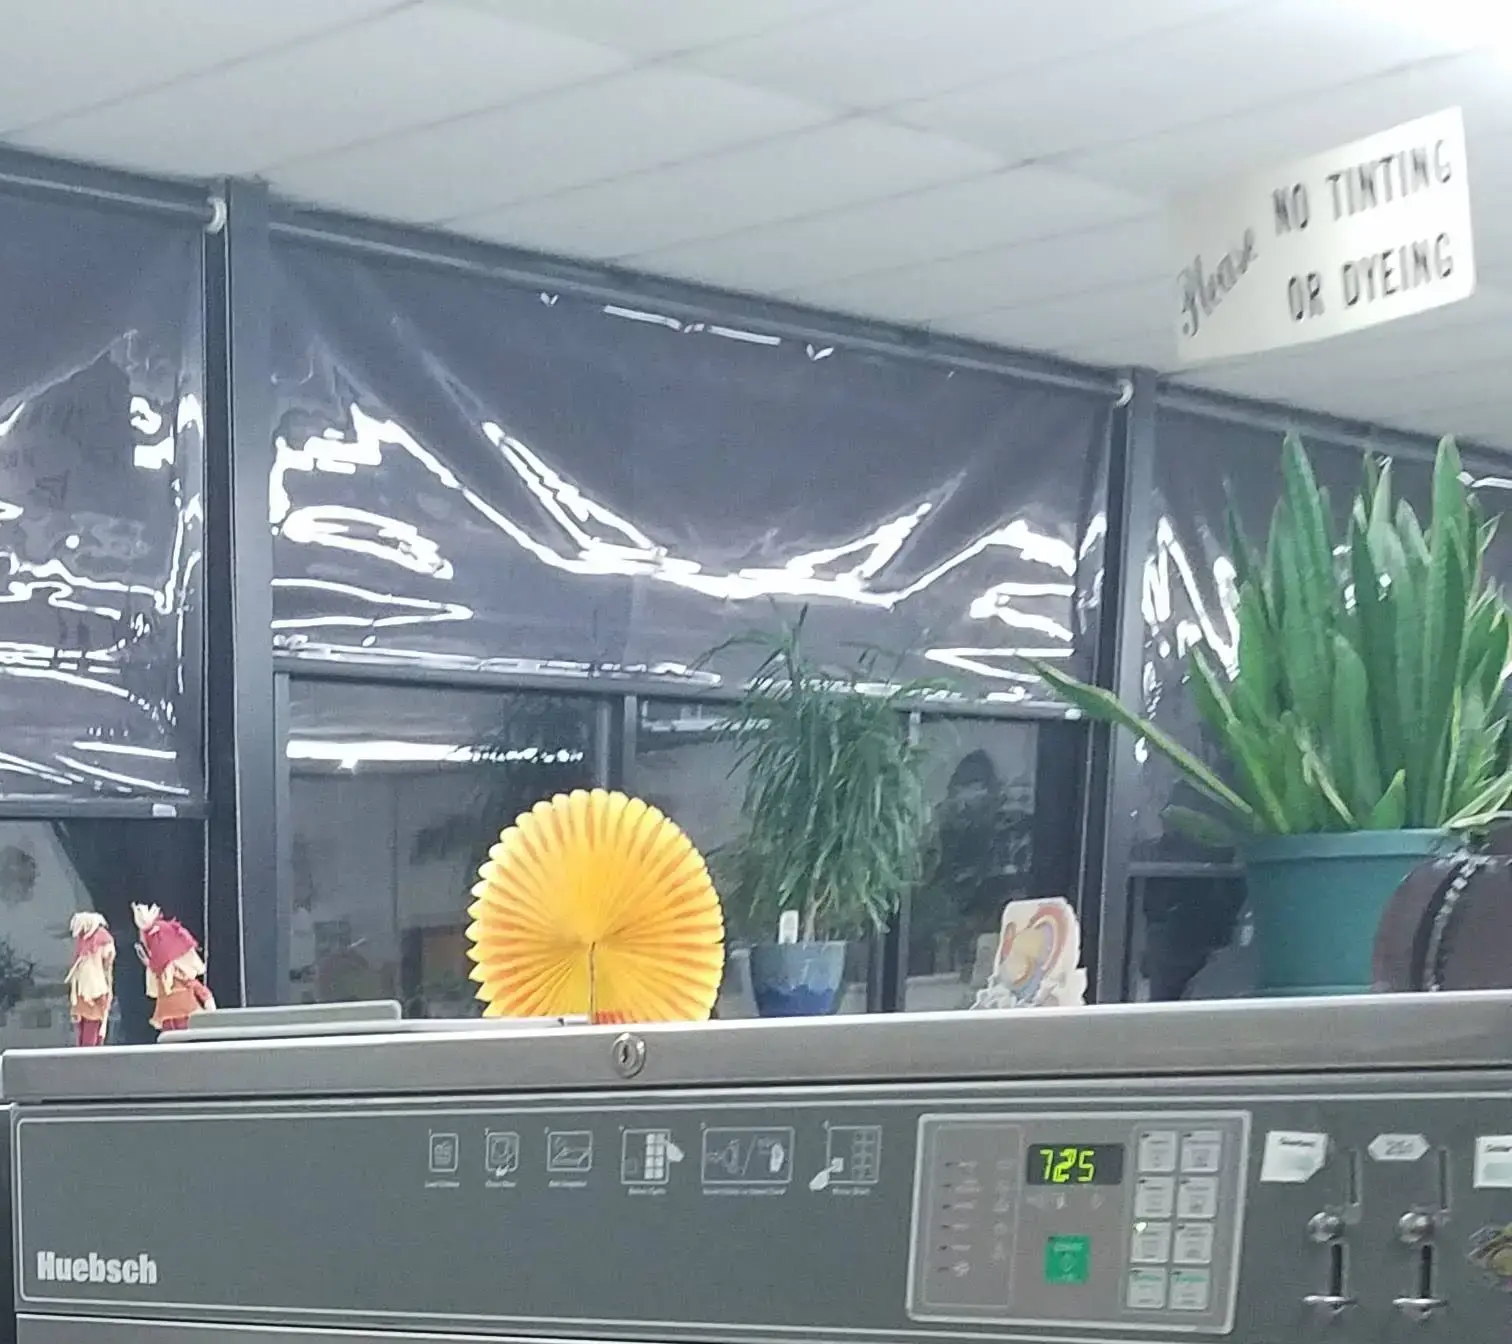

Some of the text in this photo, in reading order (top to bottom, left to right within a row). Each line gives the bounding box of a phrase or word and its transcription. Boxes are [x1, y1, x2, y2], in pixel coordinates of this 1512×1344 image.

[1271, 138, 1454, 236] NO TINTING
[1287, 232, 1455, 324] OR DYEING
[1039, 1147, 1096, 1183] 725
[36, 1250, 158, 1285] Huebsch
